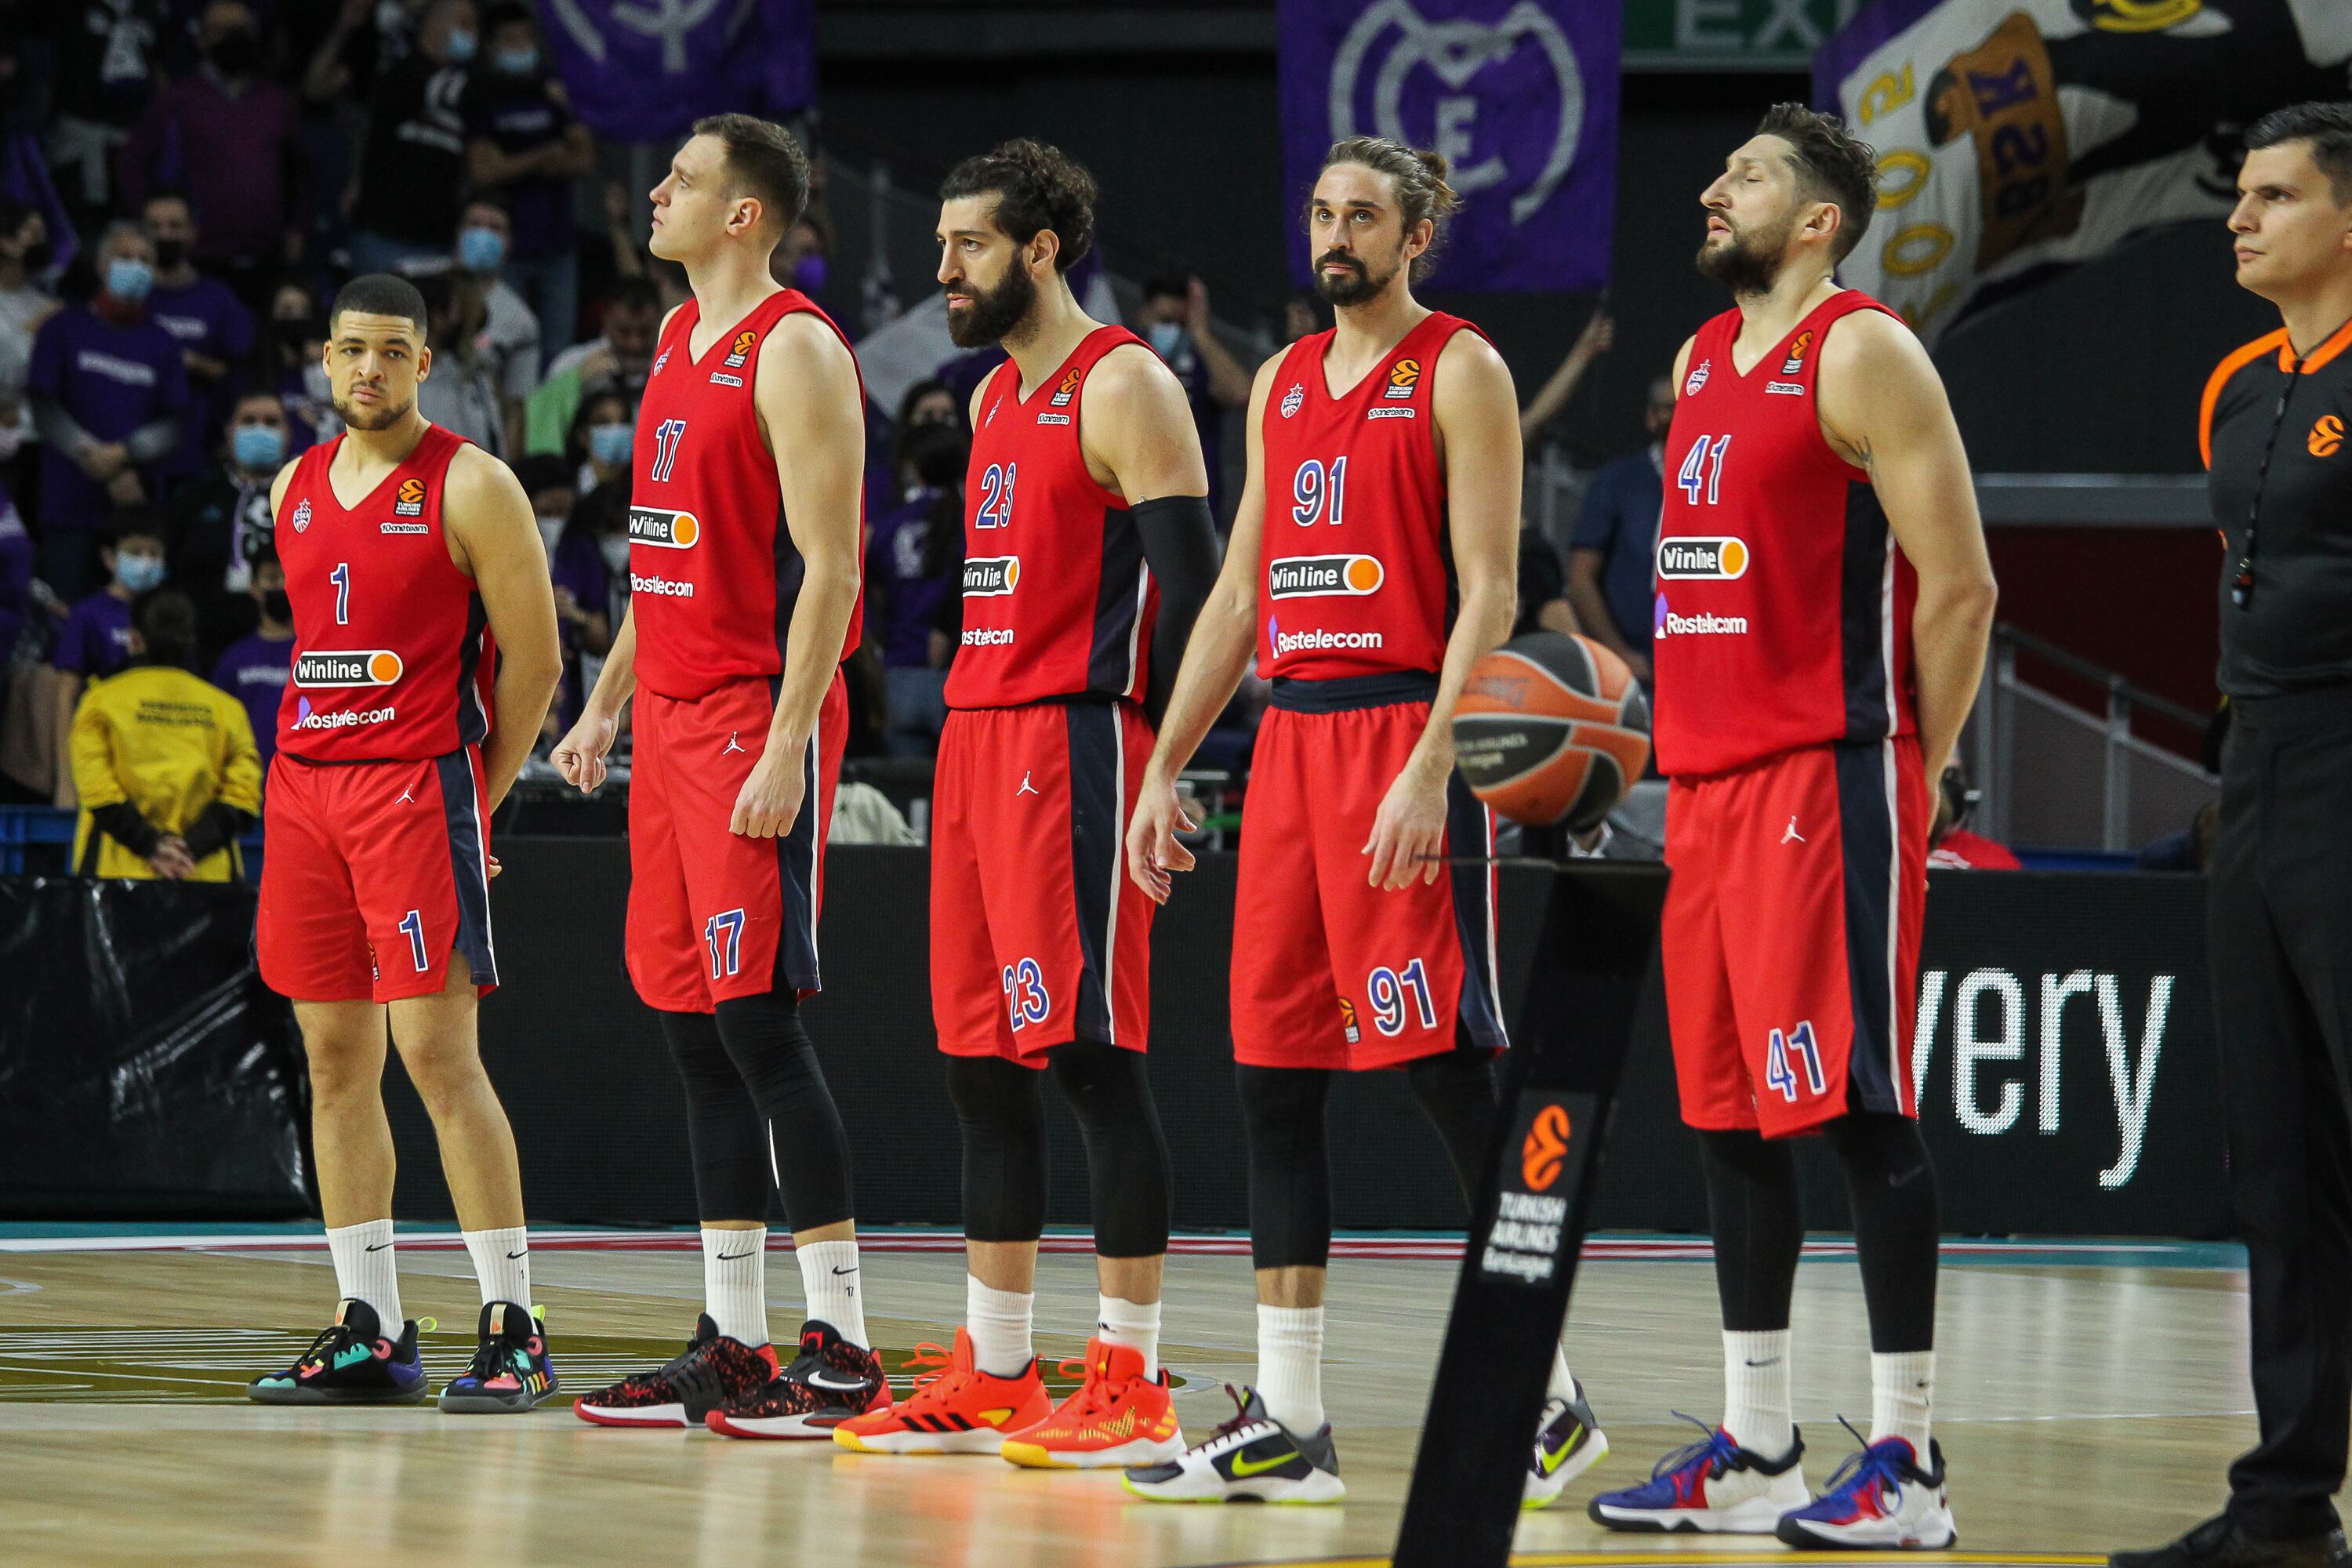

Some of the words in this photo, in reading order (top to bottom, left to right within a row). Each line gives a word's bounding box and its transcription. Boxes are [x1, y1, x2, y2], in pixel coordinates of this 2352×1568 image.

[651, 419, 688, 483] 17
[1678, 434, 1732, 506] 41
[975, 461, 1017, 530] 23
[1292, 456, 1348, 528] 91
[1272, 566, 1338, 590] Winline
[1664, 546, 1717, 569] Winline
[329, 562, 350, 626] 1
[298, 659, 362, 679] Winline
[398, 909, 430, 973] 1
[704, 906, 746, 981] 17
[1002, 956, 1051, 1033] 23
[1367, 957, 1437, 1037] 91
[1766, 1020, 1827, 1103] 41
[846, 1286, 855, 1298] 17
